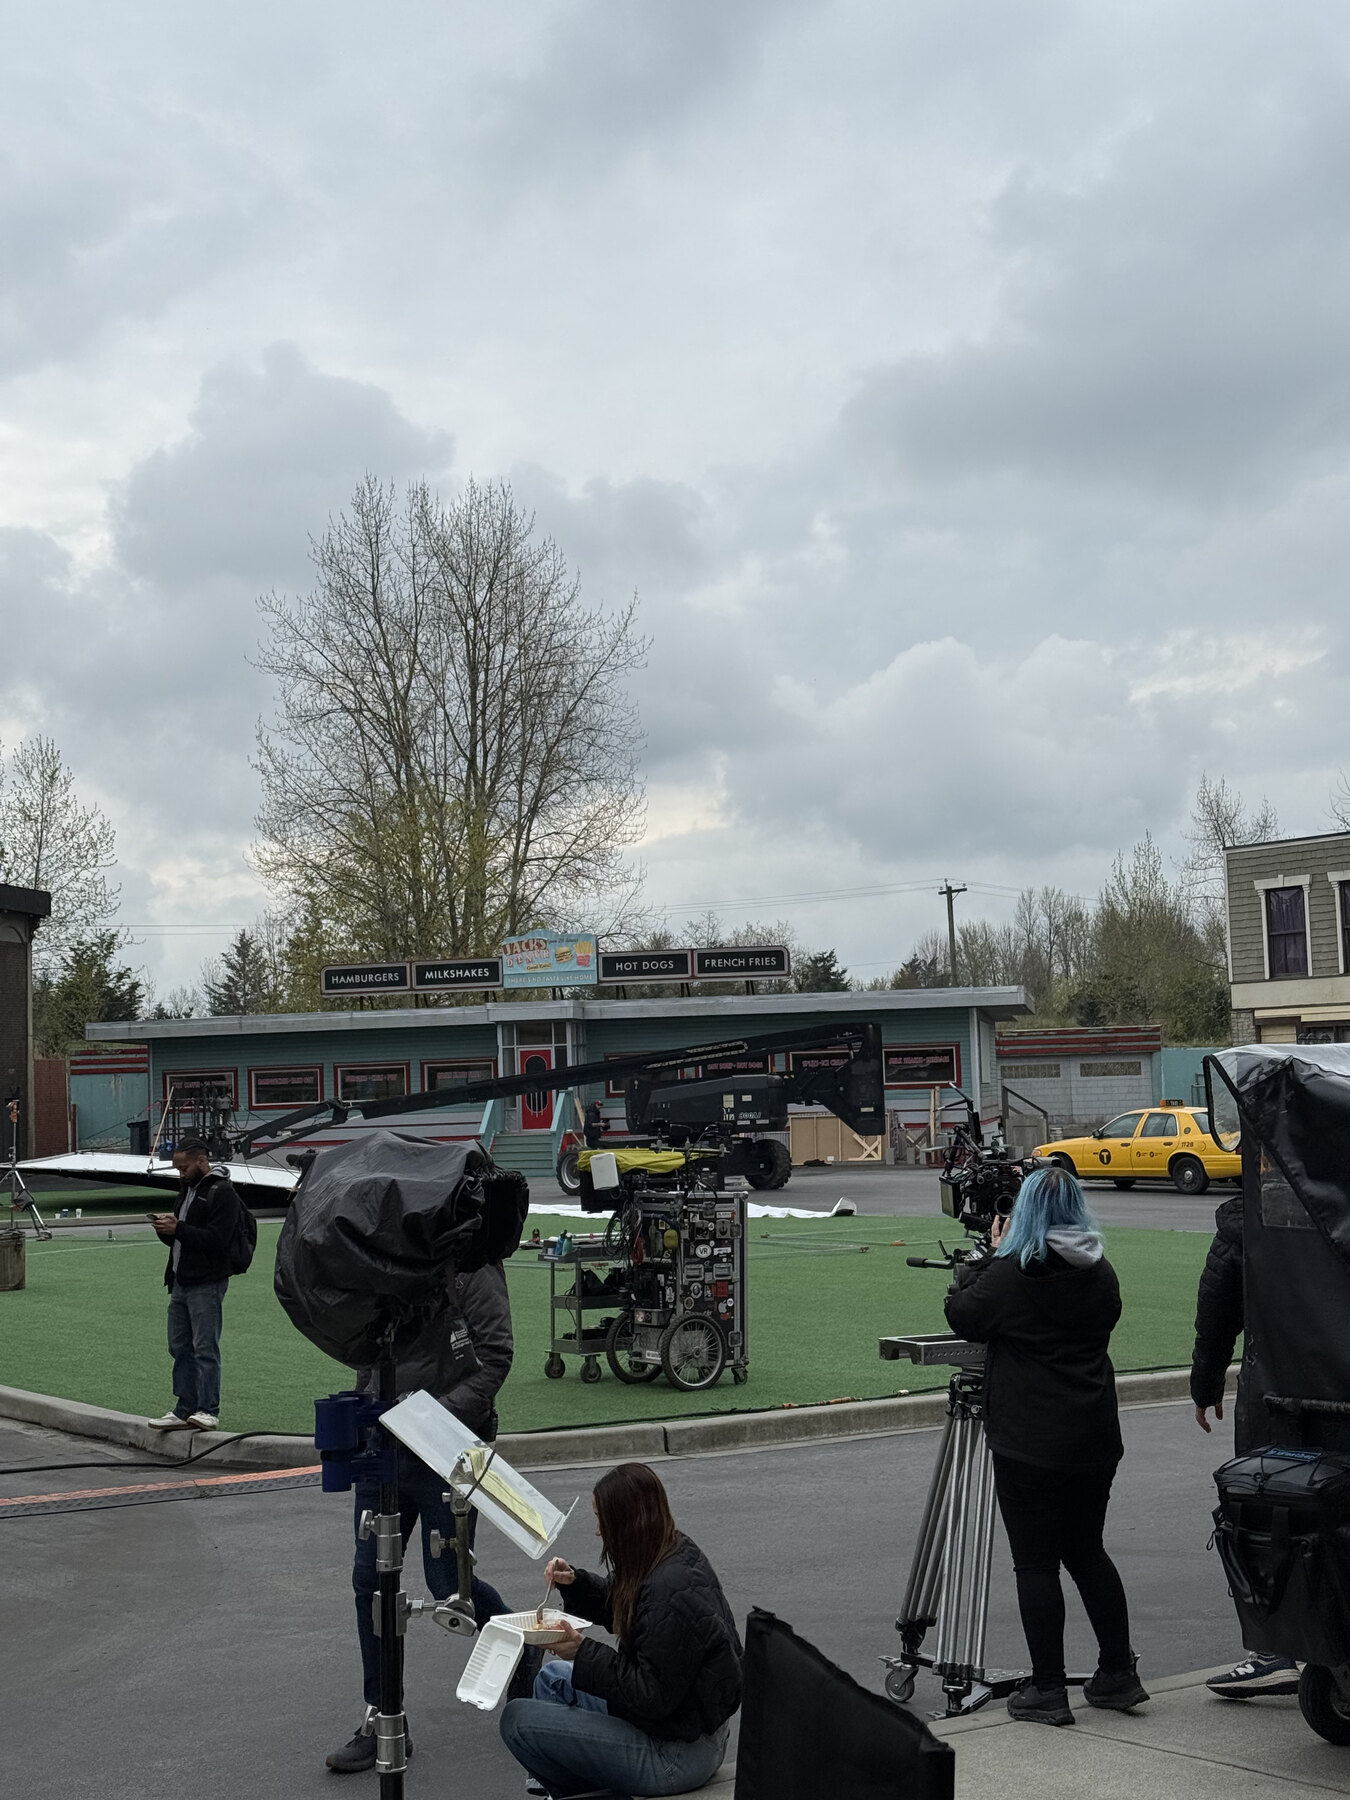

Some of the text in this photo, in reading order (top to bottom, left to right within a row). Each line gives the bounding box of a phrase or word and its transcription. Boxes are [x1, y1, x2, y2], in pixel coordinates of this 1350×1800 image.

[615, 960, 674, 971] HOT DOGS
[704, 957, 777, 968] FRENCH FRIES
[331, 972, 400, 984] HAMBURGERS
[424, 968, 490, 980] MILKSHAKES
[1101, 1151, 1109, 1164] T
[699, 1247, 708, 1255] VR
